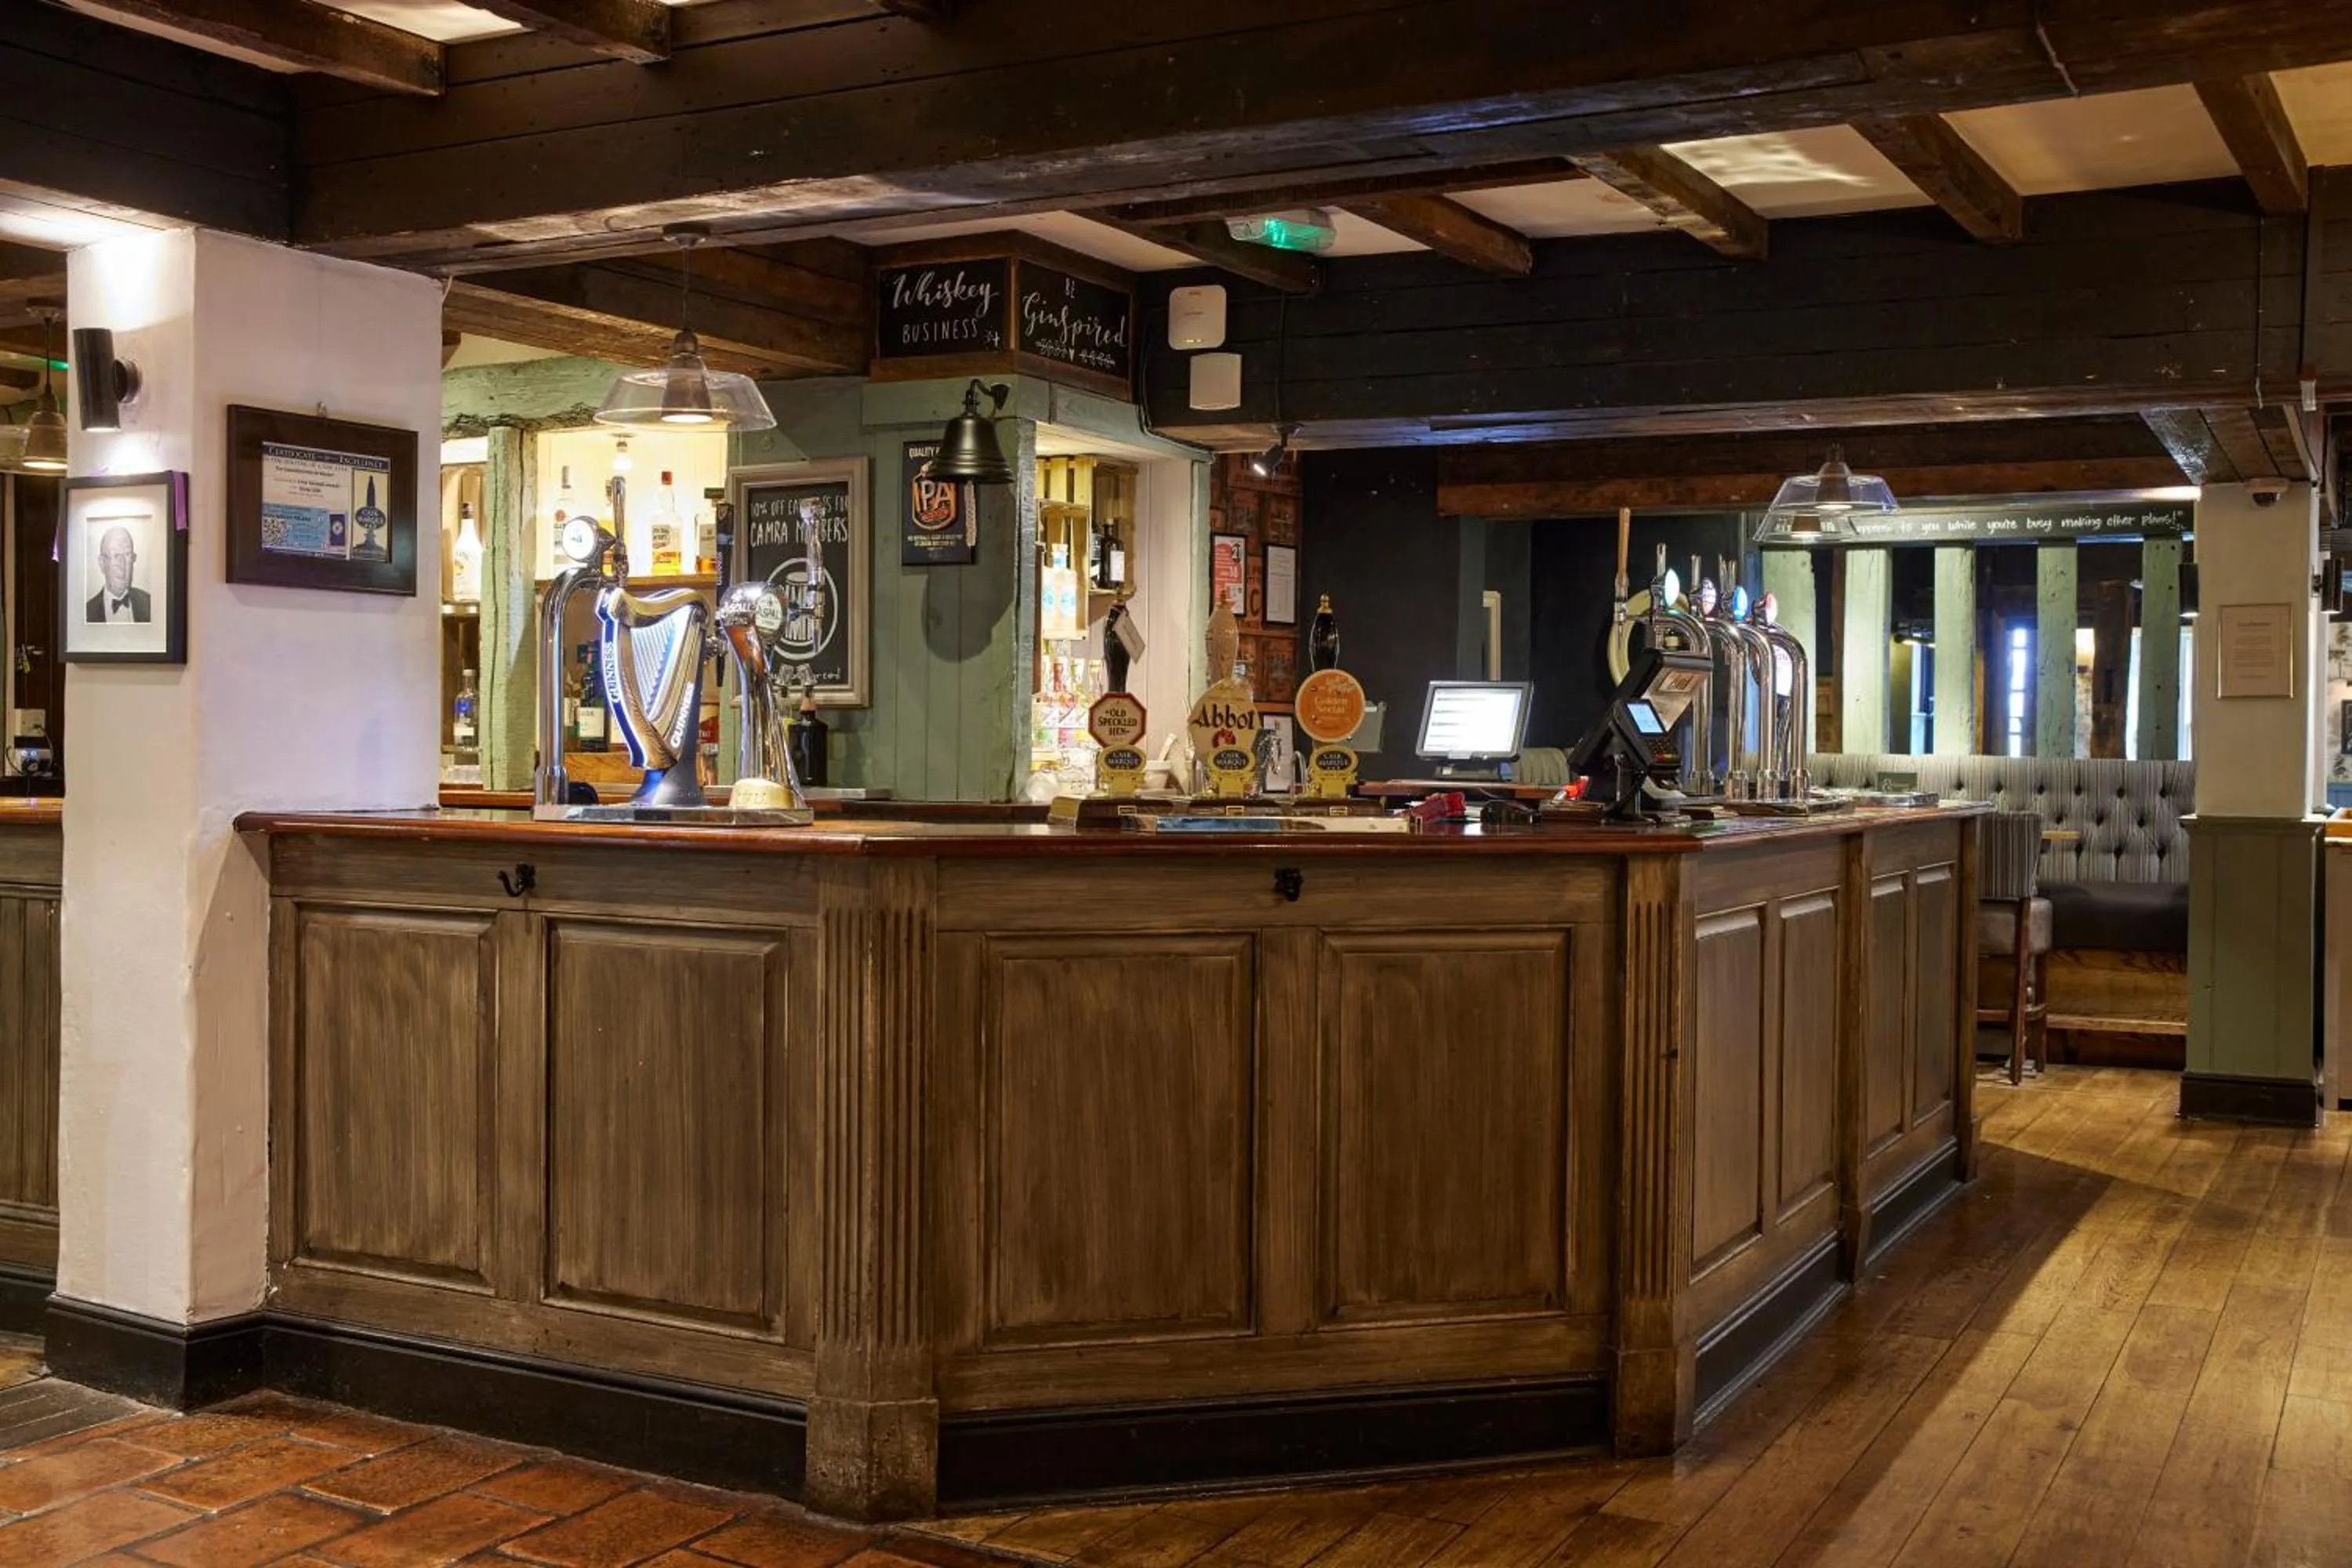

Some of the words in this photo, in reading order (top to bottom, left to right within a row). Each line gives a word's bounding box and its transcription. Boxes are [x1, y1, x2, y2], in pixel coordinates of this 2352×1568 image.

[893, 270, 1000, 318] Whiskey
[902, 318, 978, 343] BUSINESS
[909, 446, 935, 459] QUALITY
[750, 520, 788, 548] CAMRA
[796, 517, 848, 544] MBERS
[1922, 522, 1940, 535] you
[1947, 519, 1976, 532] while
[2027, 517, 2052, 532] busy
[2061, 515, 2102, 531] making
[2107, 514, 2136, 527] other
[605, 641, 619, 703] GUINNESS
[670, 682, 695, 748] GUINNESS
[1098, 717, 1138, 727] SPECKLED
[1109, 708, 1127, 717] OLD
[1191, 702, 1256, 730] Abbot
[1108, 727, 1127, 736] HEN
